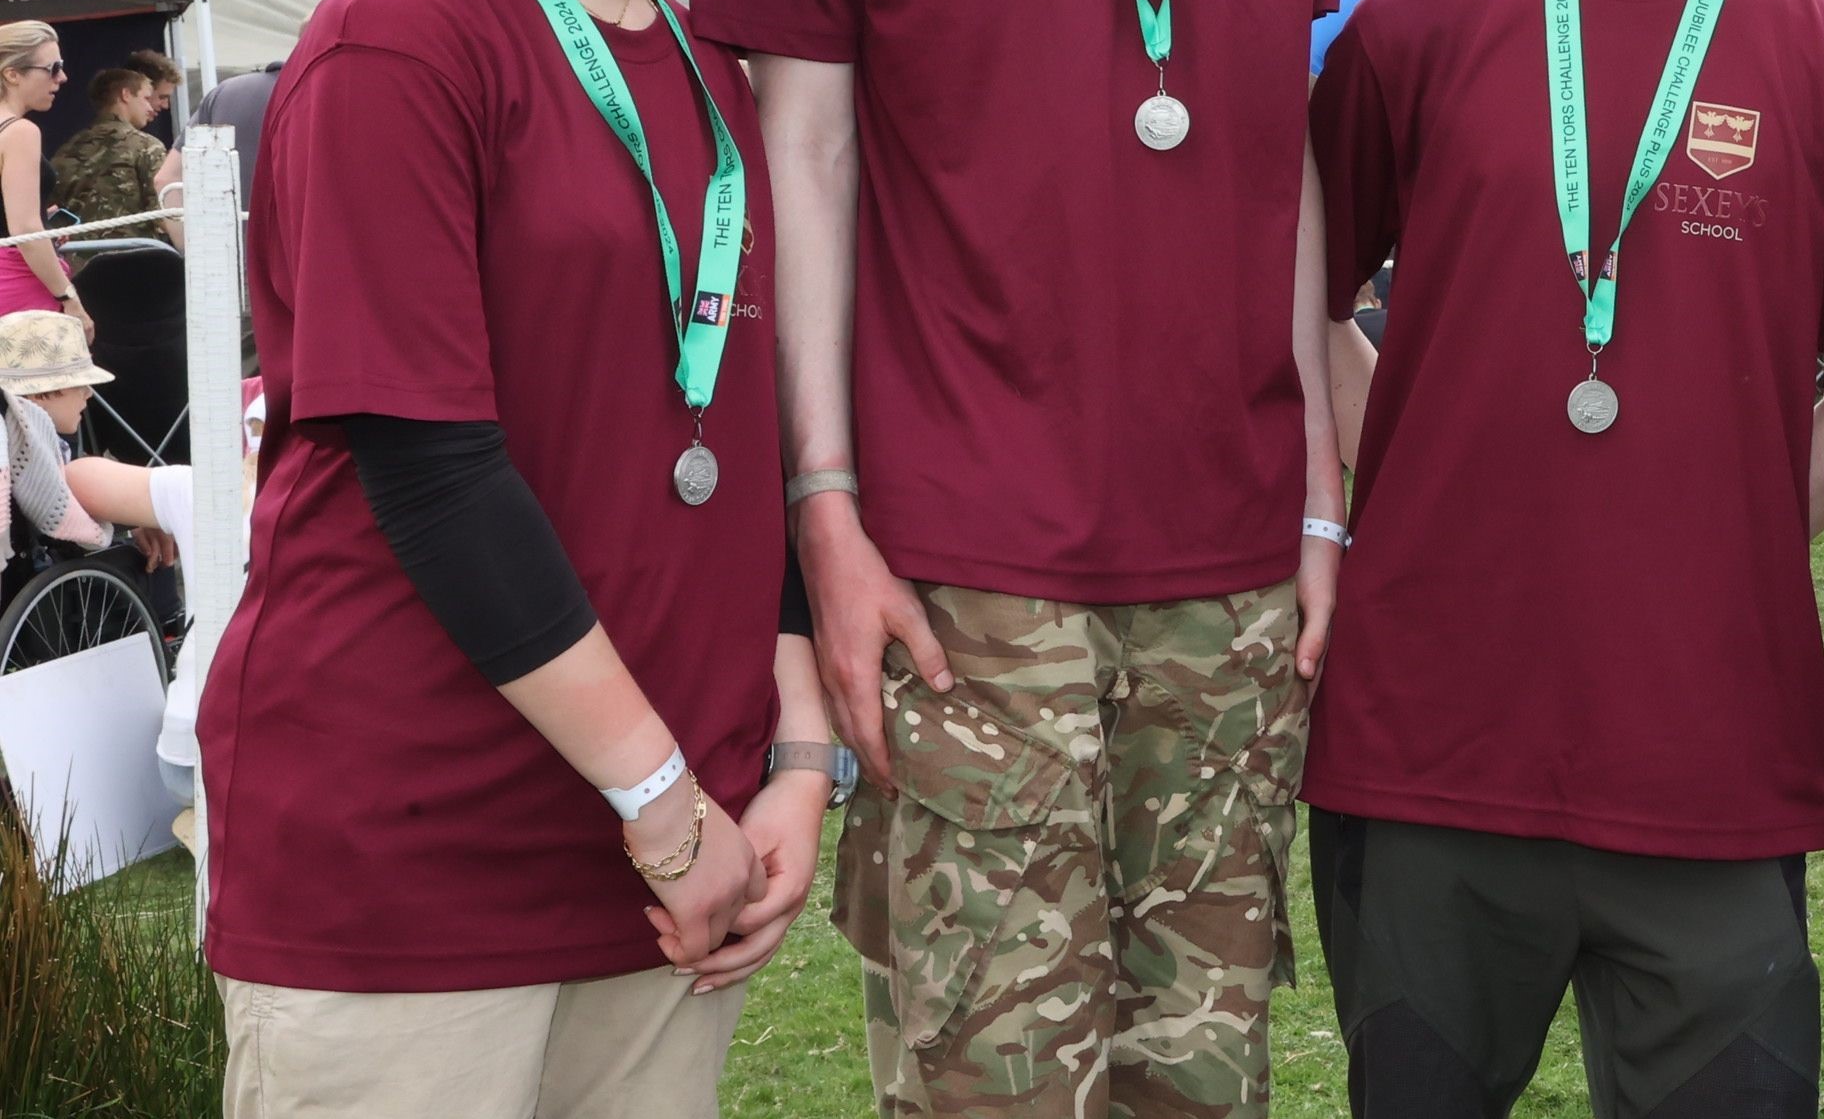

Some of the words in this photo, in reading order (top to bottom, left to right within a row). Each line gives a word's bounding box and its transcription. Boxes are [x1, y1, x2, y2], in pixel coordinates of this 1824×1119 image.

[554, 1, 583, 34] 2024
[1556, 13, 1574, 102] CHALLENGE
[574, 36, 630, 129] CHALLENGE
[1653, 56, 1690, 140] CHALLENGE
[1562, 104, 1577, 145] TORS
[1565, 148, 1578, 180] TEN
[1640, 140, 1661, 178] PLUS
[717, 183, 733, 212] TEN
[1567, 181, 1579, 213] THE
[1654, 182, 1769, 227] SEXEY'S
[713, 217, 731, 249] THE
[1681, 220, 1744, 241] SCHOOL
[707, 296, 720, 322] ARMY
